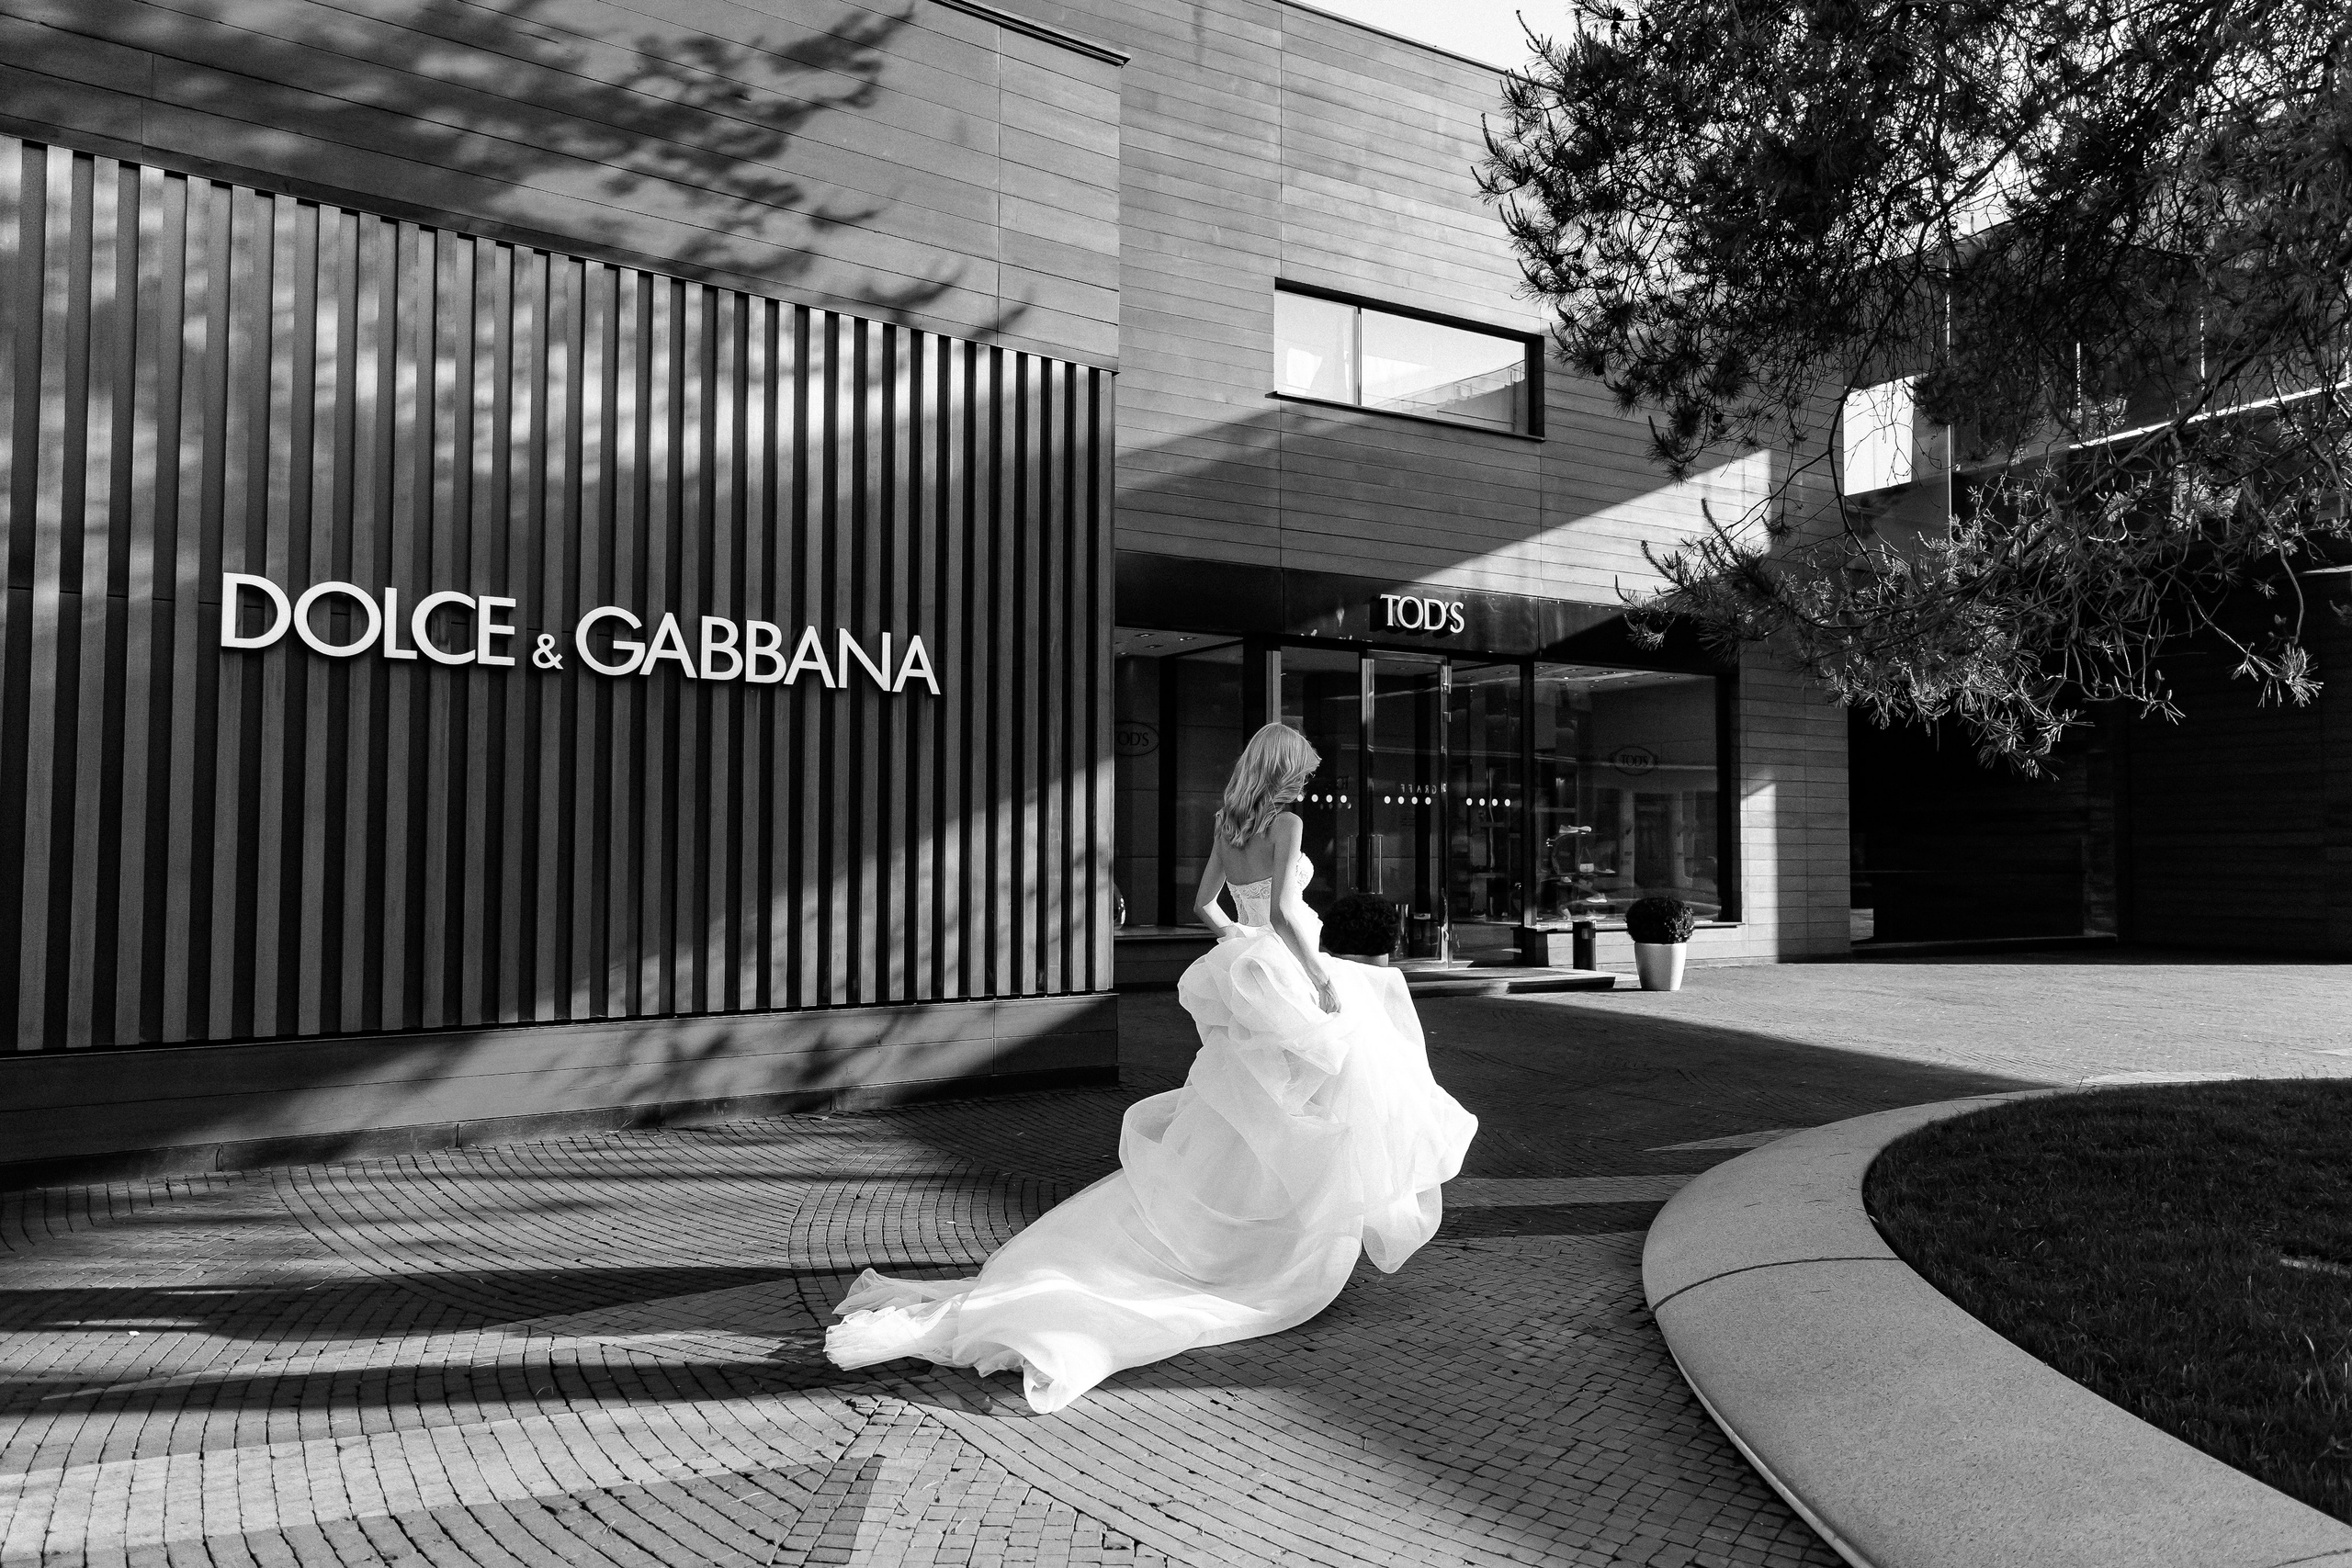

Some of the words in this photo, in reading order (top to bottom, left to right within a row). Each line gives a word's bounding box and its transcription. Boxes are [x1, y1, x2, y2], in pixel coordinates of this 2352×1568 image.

[1379, 593, 1465, 634] TOD'S
[220, 571, 516, 666] DOLCE
[532, 633, 564, 670] &
[575, 605, 941, 695] GABBANA
[1115, 731, 1149, 747] OD'S
[1620, 754, 1649, 768] TOD'S
